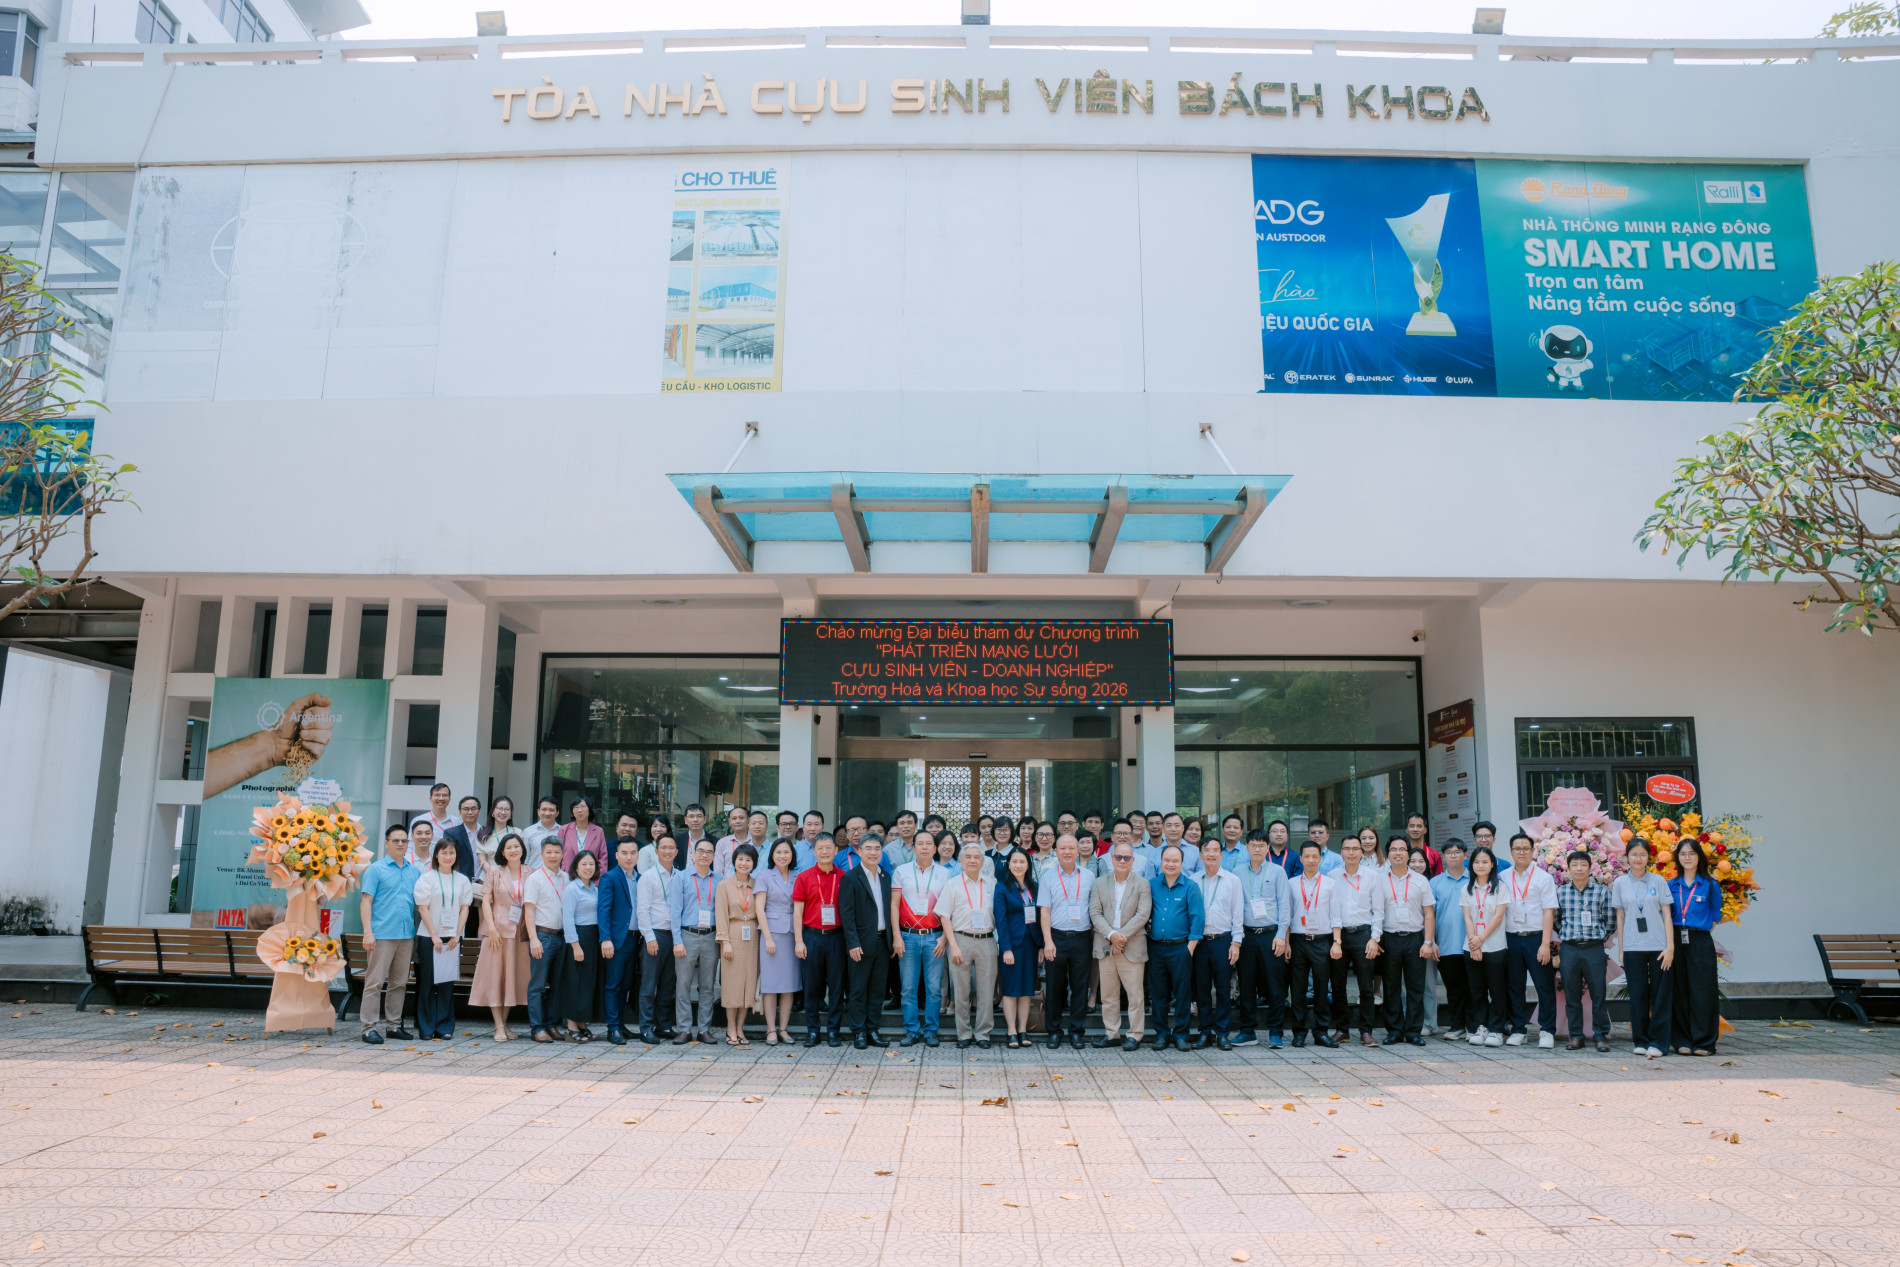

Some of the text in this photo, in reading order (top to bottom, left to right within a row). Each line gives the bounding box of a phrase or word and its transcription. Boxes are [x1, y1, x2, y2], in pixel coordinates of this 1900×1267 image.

[491, 69, 1491, 123] TÒA NHÀ CỰU SINH VIÊN BÁCH KHOA
[681, 168, 777, 187] CHO THUÊ
[1706, 185, 1739, 199] Ralli
[1254, 199, 1325, 226] ADG
[1522, 216, 1772, 237] NHÀ THÔNG MINH RẠNG ĐÔNG
[1266, 233, 1327, 243] AUSTDOOR
[1523, 237, 1777, 271] SMART HOME
[1525, 272, 1644, 293] Trọn an tâm
[1528, 291, 1736, 318] Nâng tầm cuộc sống
[1292, 312, 1340, 331] QUỐC
[1344, 317, 1375, 332] GIA
[704, 382, 725, 391] KHO
[727, 382, 771, 391] LOGISTIC
[1453, 376, 1474, 384] LUFA
[816, 623, 1139, 642] Chào mừng Đại biểu tham dự Chương trình
[876, 641, 1078, 660] "PHÁT TRIỂN MẠNG LƯỚI
[841, 662, 880, 678] CỰU
[885, 663, 924, 677] SINH
[928, 660, 967, 677] VIÊN
[983, 663, 1041, 677] DOANH
[1045, 661, 1114, 679] NGHIỆP"
[831, 680, 1128, 699] Trường Hoá và Khoa học Sự sống 2026
[290, 711, 342, 724] Argentina
[217, 909, 244, 927] INTA
